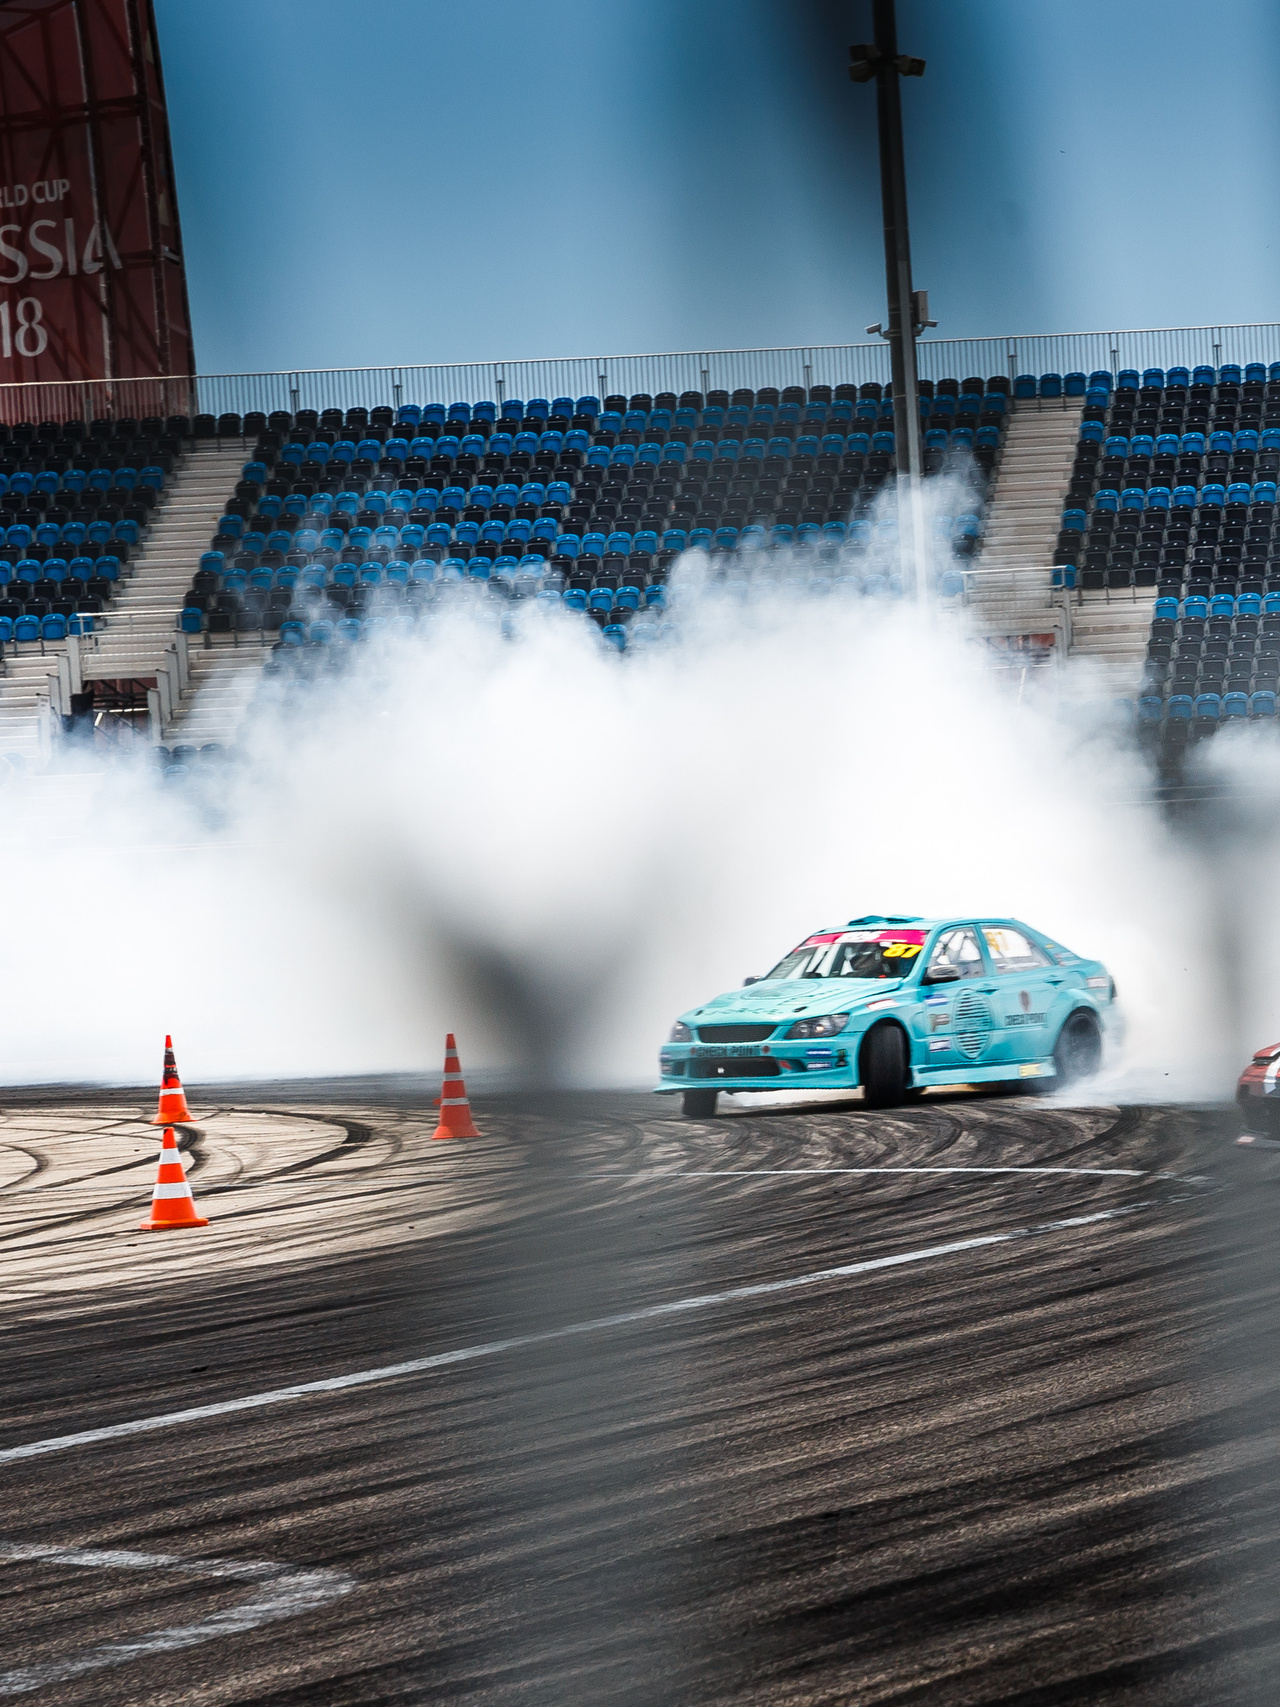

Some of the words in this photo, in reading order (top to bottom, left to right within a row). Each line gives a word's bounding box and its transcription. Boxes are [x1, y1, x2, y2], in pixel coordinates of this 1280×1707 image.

[32, 178, 70, 204] CUP
[0, 297, 48, 357] 18
[883, 943, 924, 958] 87
